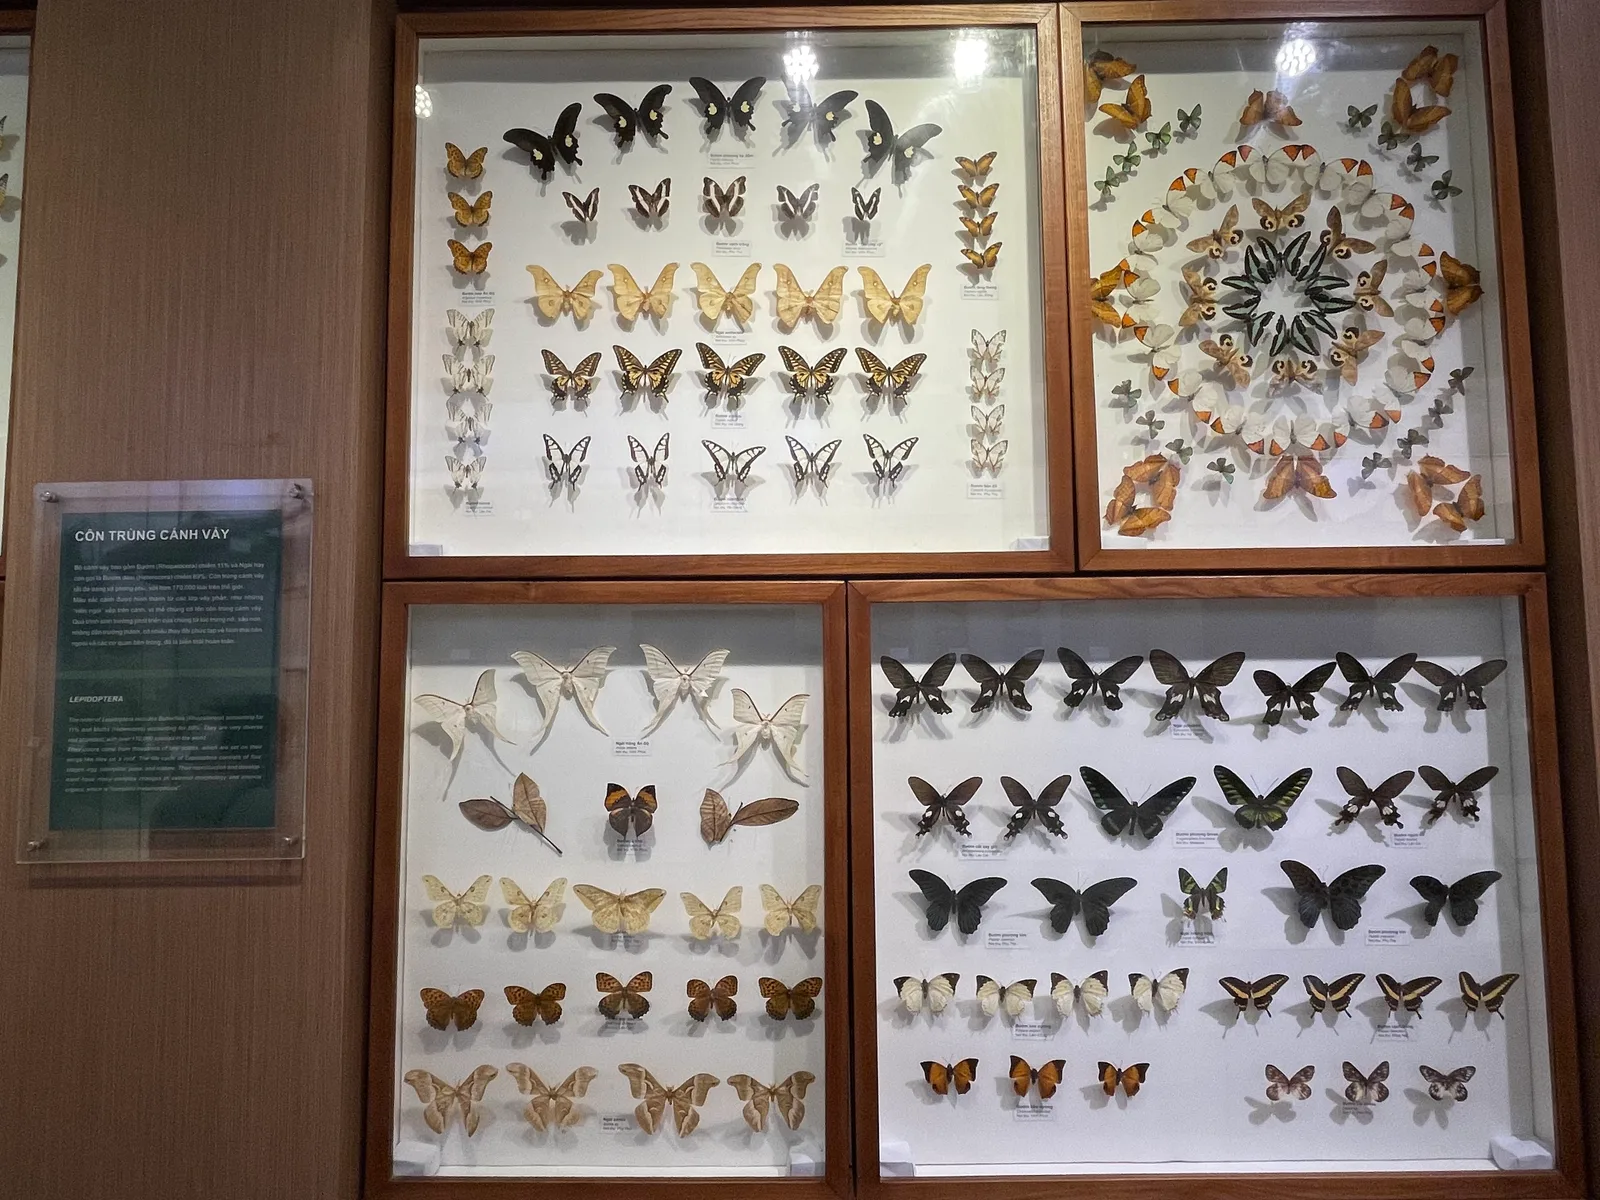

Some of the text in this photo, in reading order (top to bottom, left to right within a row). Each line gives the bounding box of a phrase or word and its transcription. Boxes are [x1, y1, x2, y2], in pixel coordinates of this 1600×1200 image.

[74, 526, 230, 542] CÔN TRÙNG CÁNH VẢY
[68, 695, 124, 703] LEPIDOPTERA
